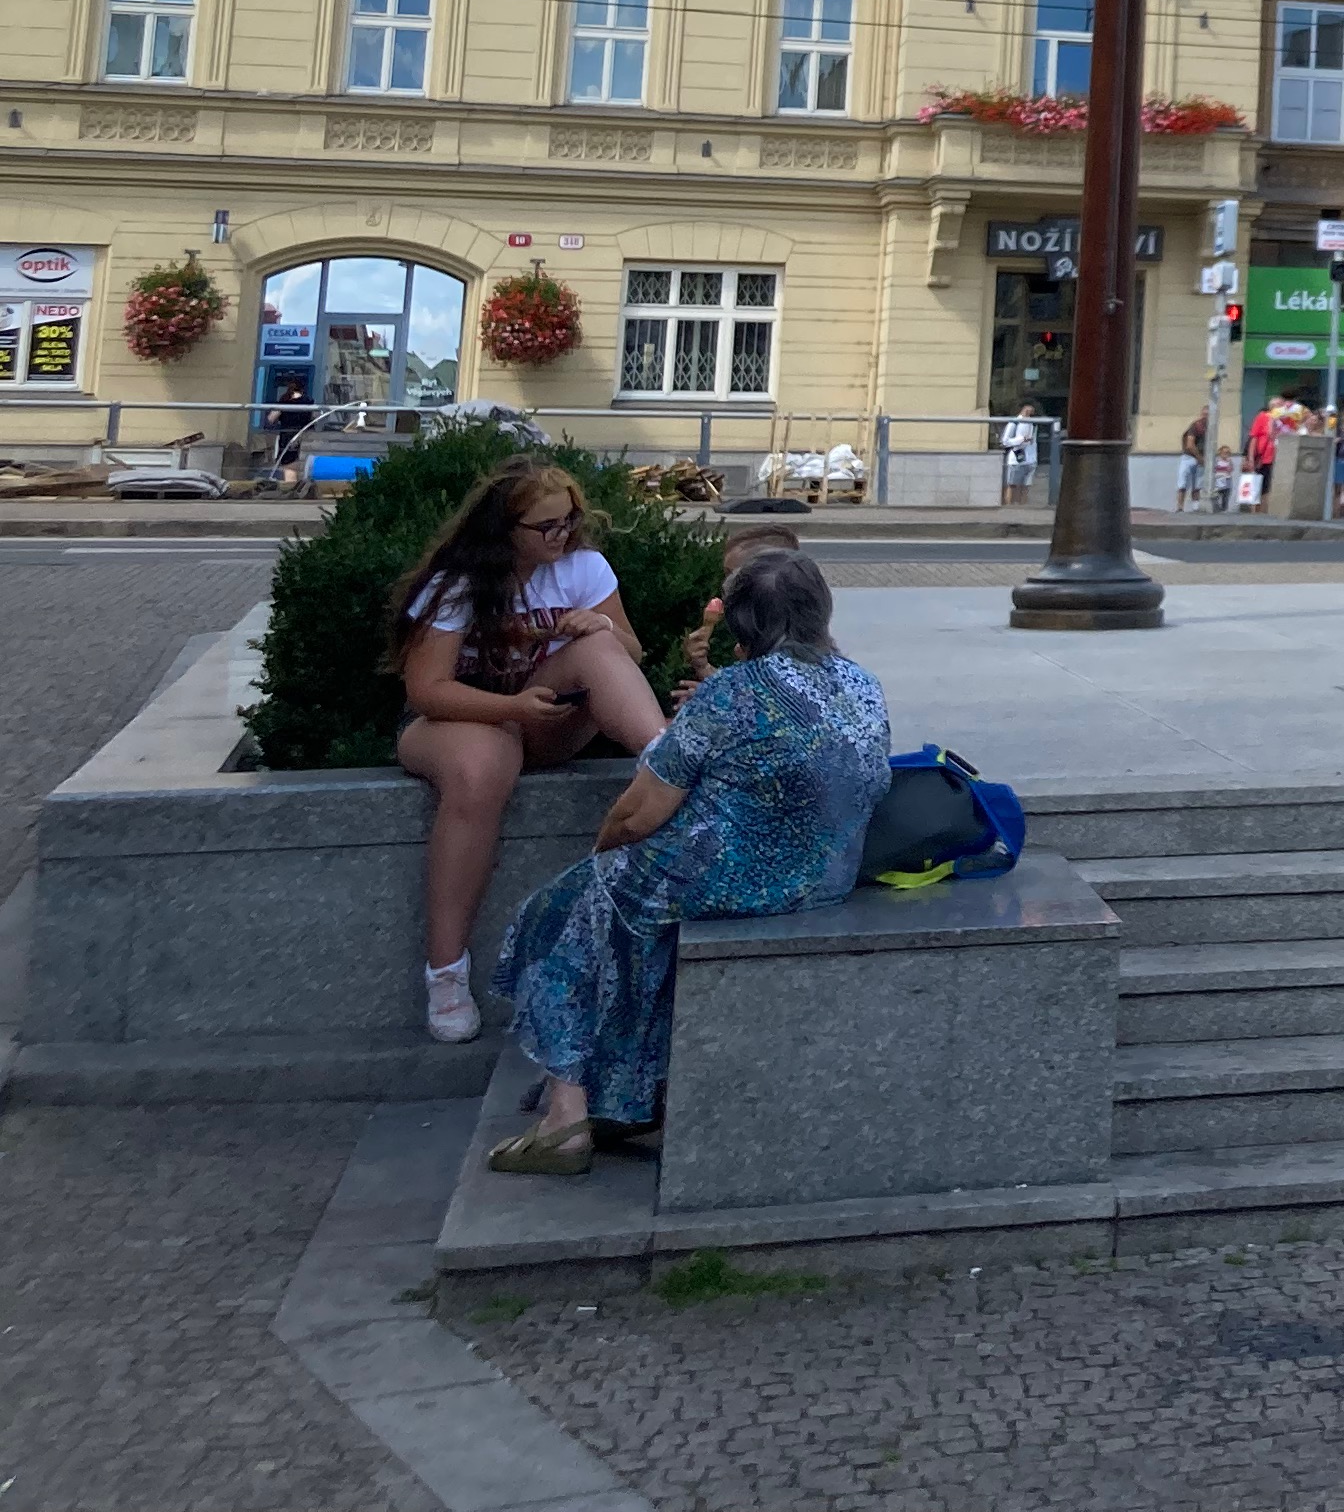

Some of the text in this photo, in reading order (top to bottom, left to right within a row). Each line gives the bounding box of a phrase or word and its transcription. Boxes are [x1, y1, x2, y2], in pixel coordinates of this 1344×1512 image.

[515, 235, 526, 245] 10
[21, 257, 71, 274] optik
[1274, 290, 1335, 311] Lékár
[36, 305, 80, 317] NEBO
